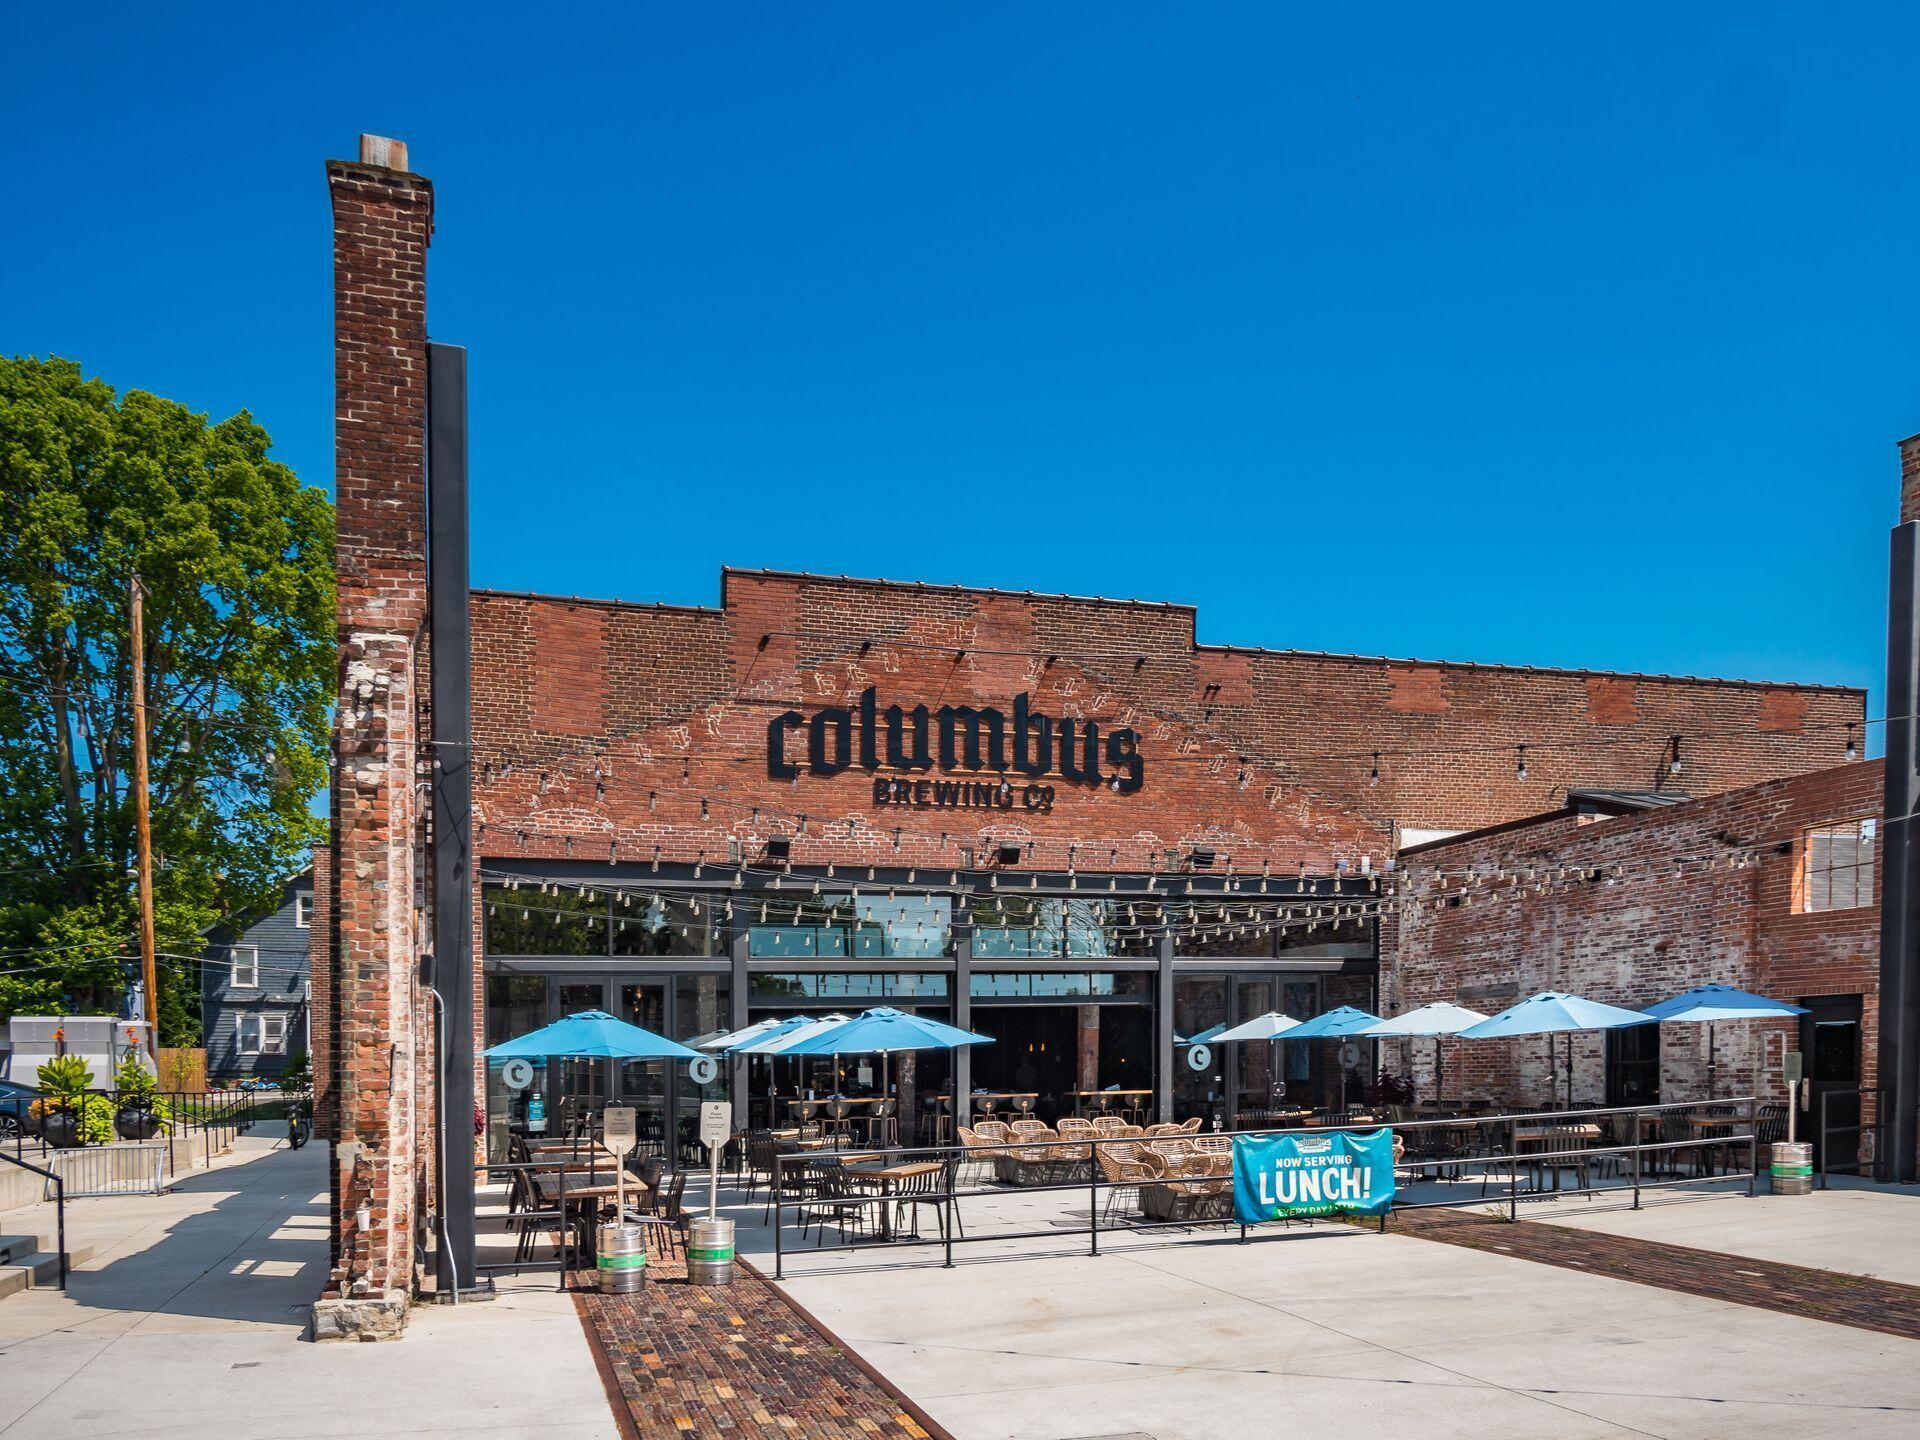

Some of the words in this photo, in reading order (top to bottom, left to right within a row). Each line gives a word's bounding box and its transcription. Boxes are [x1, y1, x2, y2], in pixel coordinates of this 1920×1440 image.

[768, 686, 1144, 794] columbus
[872, 777, 1014, 810] BREWING
[1275, 1158, 1302, 1168] NOW
[1304, 1154, 1352, 1167] SERVING
[1259, 1166, 1371, 1205] LUNCH!
[1277, 1206, 1308, 1217] EVERY
[1309, 1205, 1327, 1214] DAY
